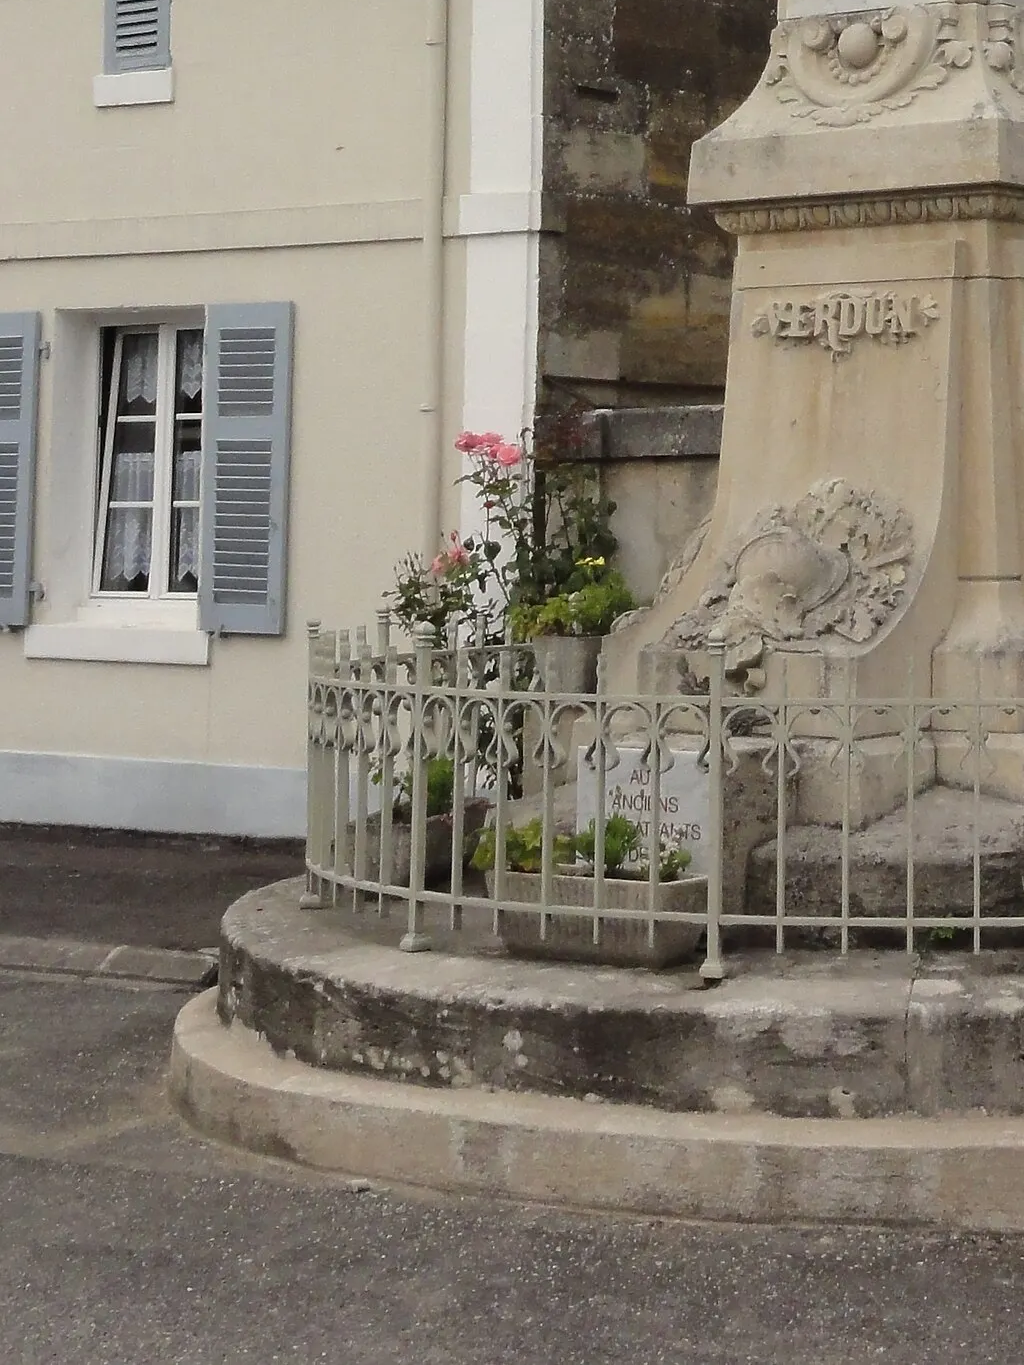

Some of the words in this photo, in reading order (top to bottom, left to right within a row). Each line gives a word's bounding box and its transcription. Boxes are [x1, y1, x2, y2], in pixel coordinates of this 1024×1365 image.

[768, 292, 918, 342] VERDUN
[630, 769, 652, 785] AU
[612, 794, 679, 813] ANCINS
